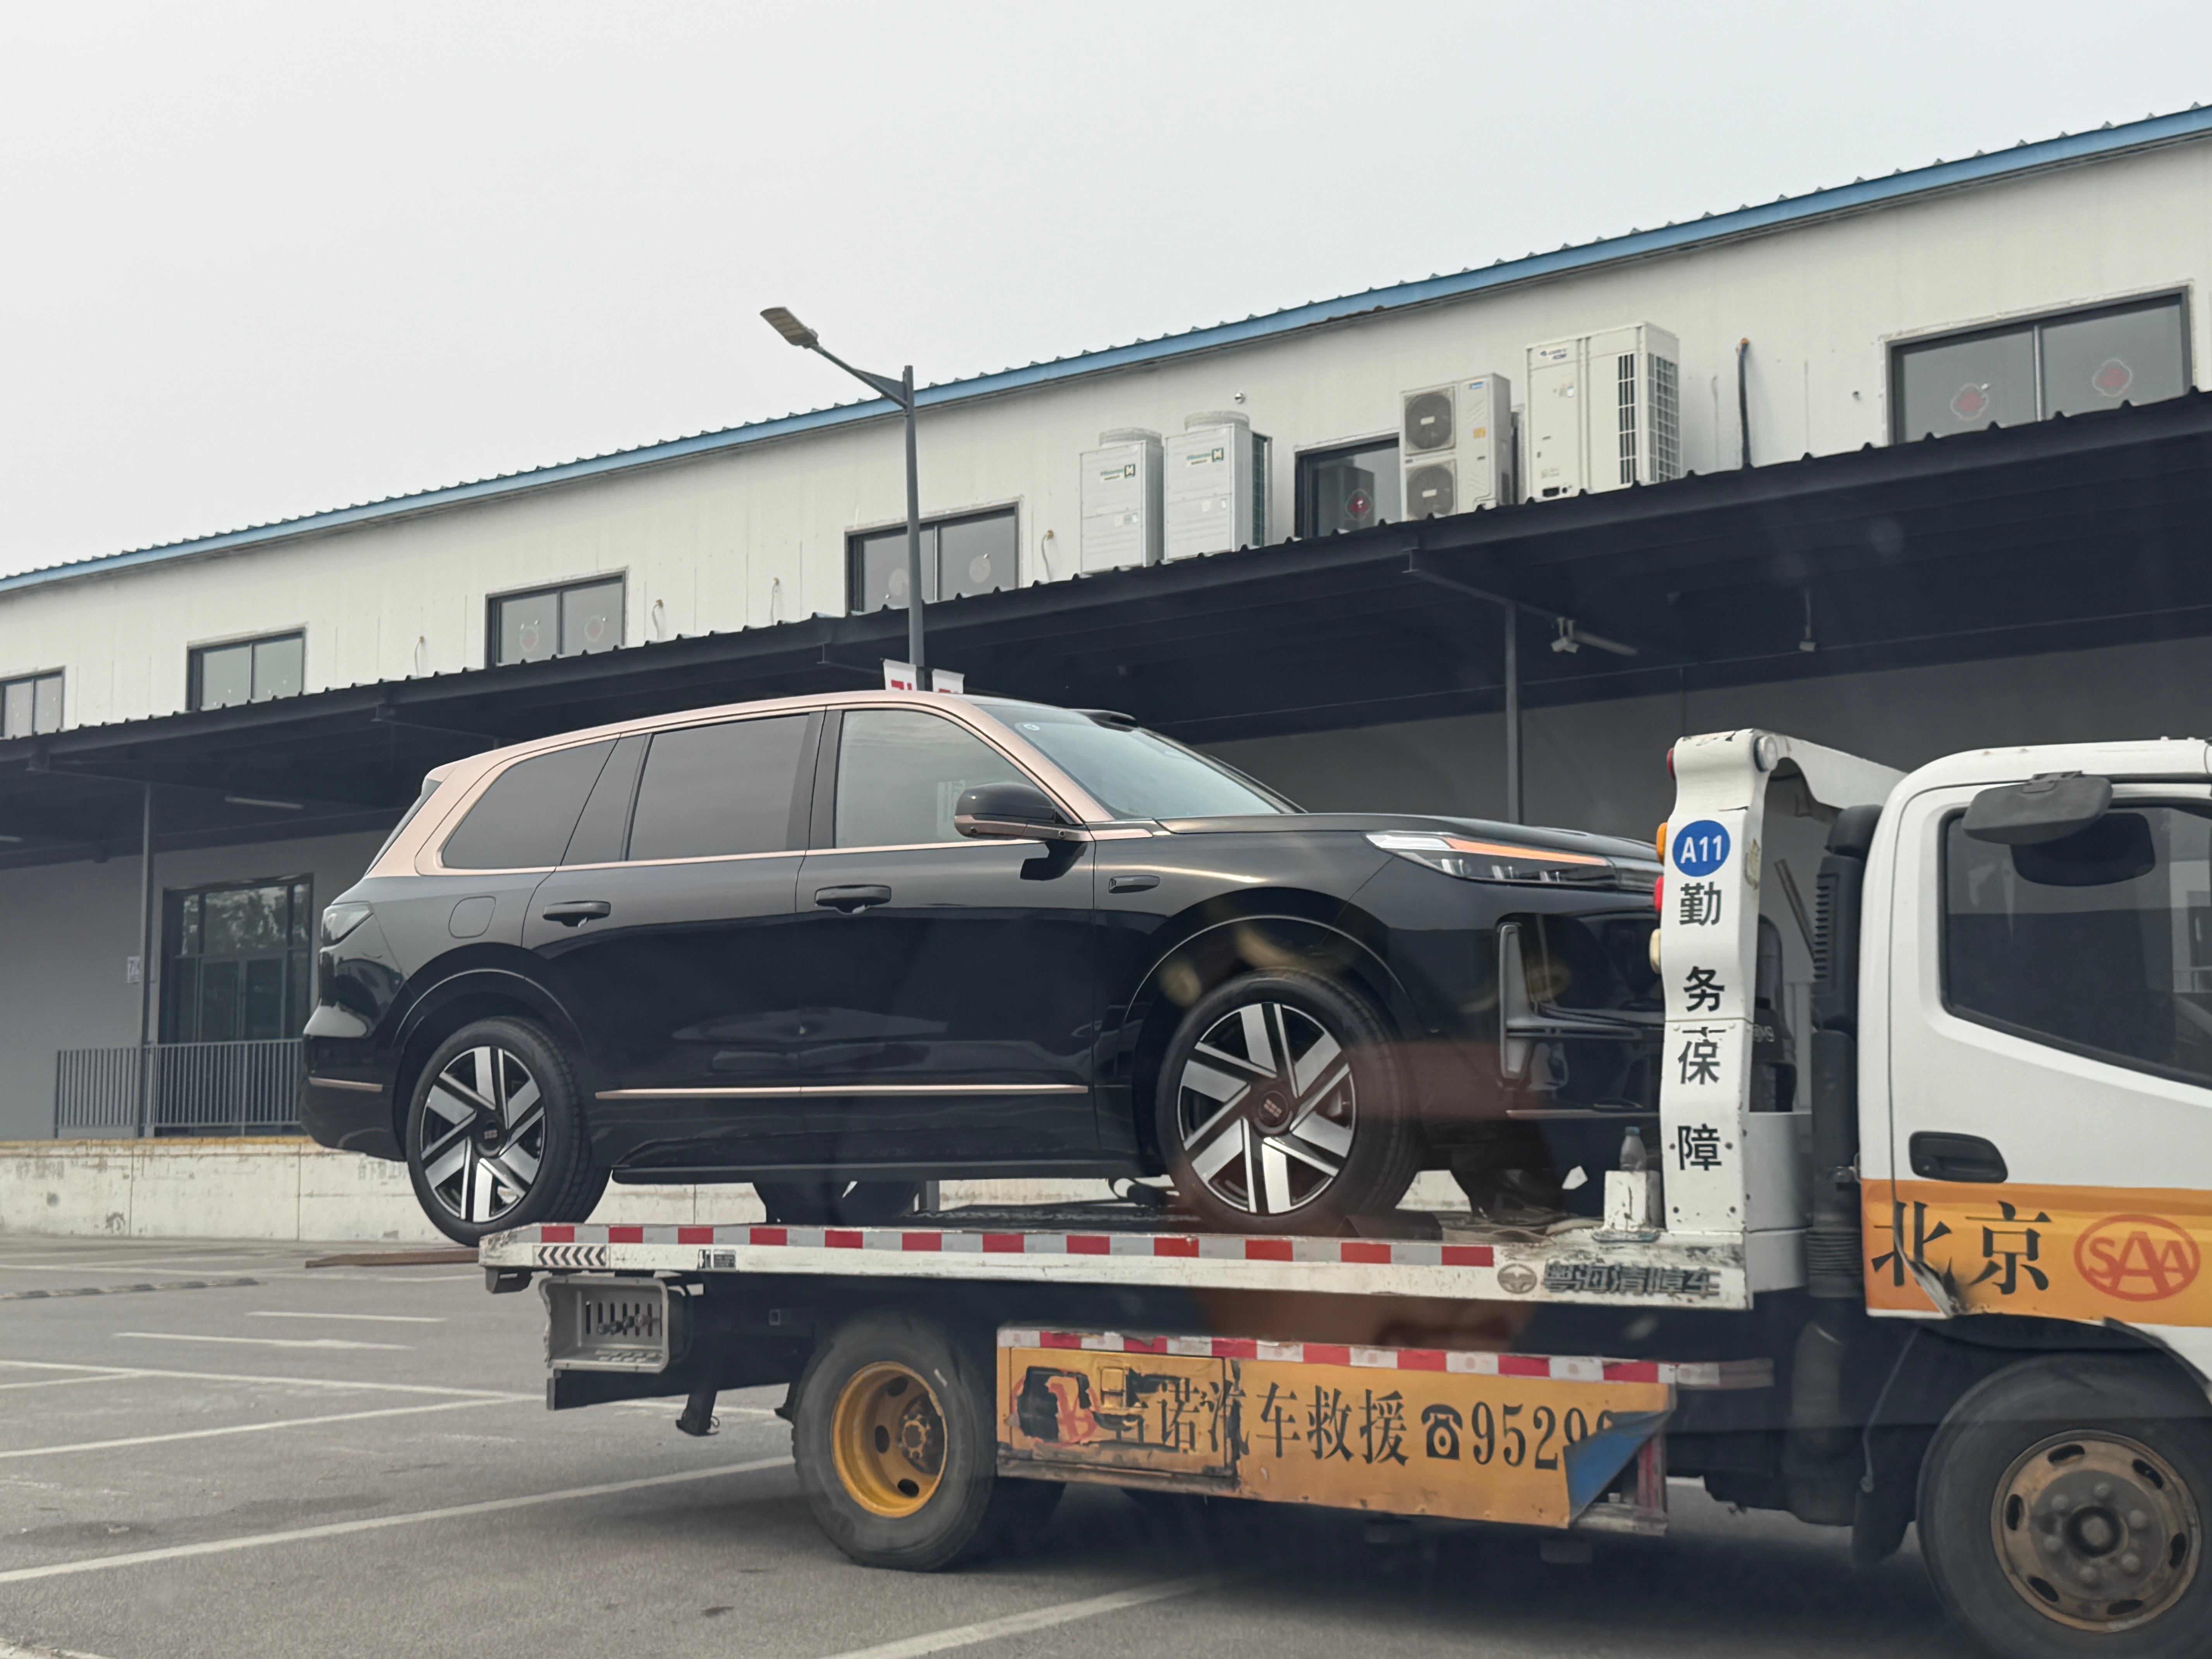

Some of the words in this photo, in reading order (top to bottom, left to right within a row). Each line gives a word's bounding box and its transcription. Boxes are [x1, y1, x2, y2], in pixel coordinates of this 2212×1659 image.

[1680, 835, 1722, 864] A11
[1678, 881, 1725, 1171] 勤务保障
[1871, 1200, 2052, 1295] 北京
[2088, 1231, 2192, 1295] SAA
